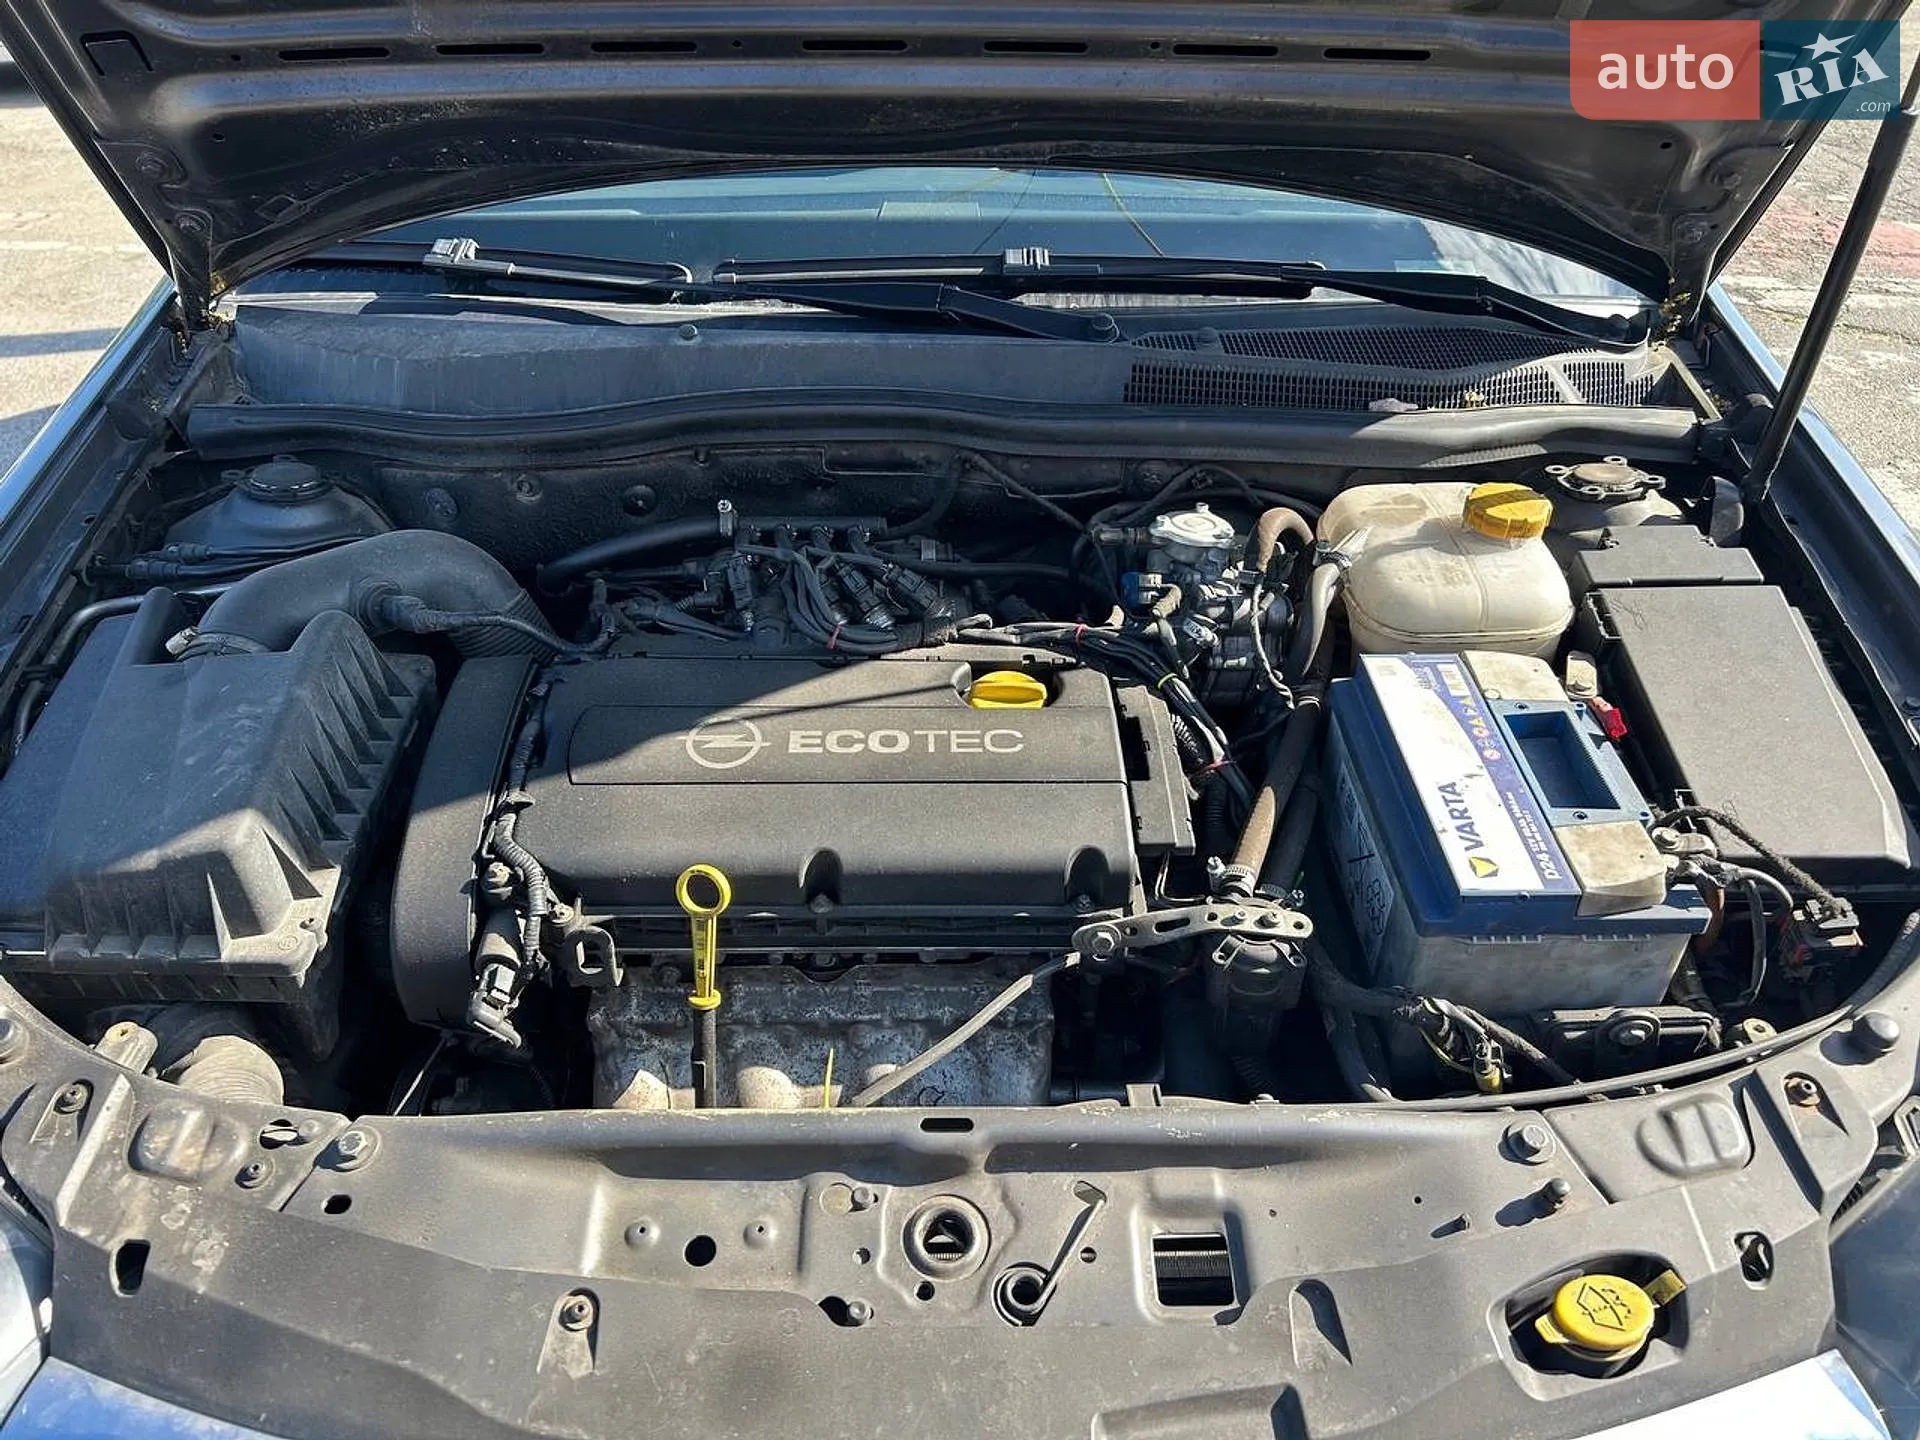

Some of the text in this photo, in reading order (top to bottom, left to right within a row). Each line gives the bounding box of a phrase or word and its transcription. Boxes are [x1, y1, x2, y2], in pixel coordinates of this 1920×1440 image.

[788, 729, 1025, 753] ECOTEC
[1437, 781, 1485, 852] VARTA
[1535, 852, 1562, 880] D24
